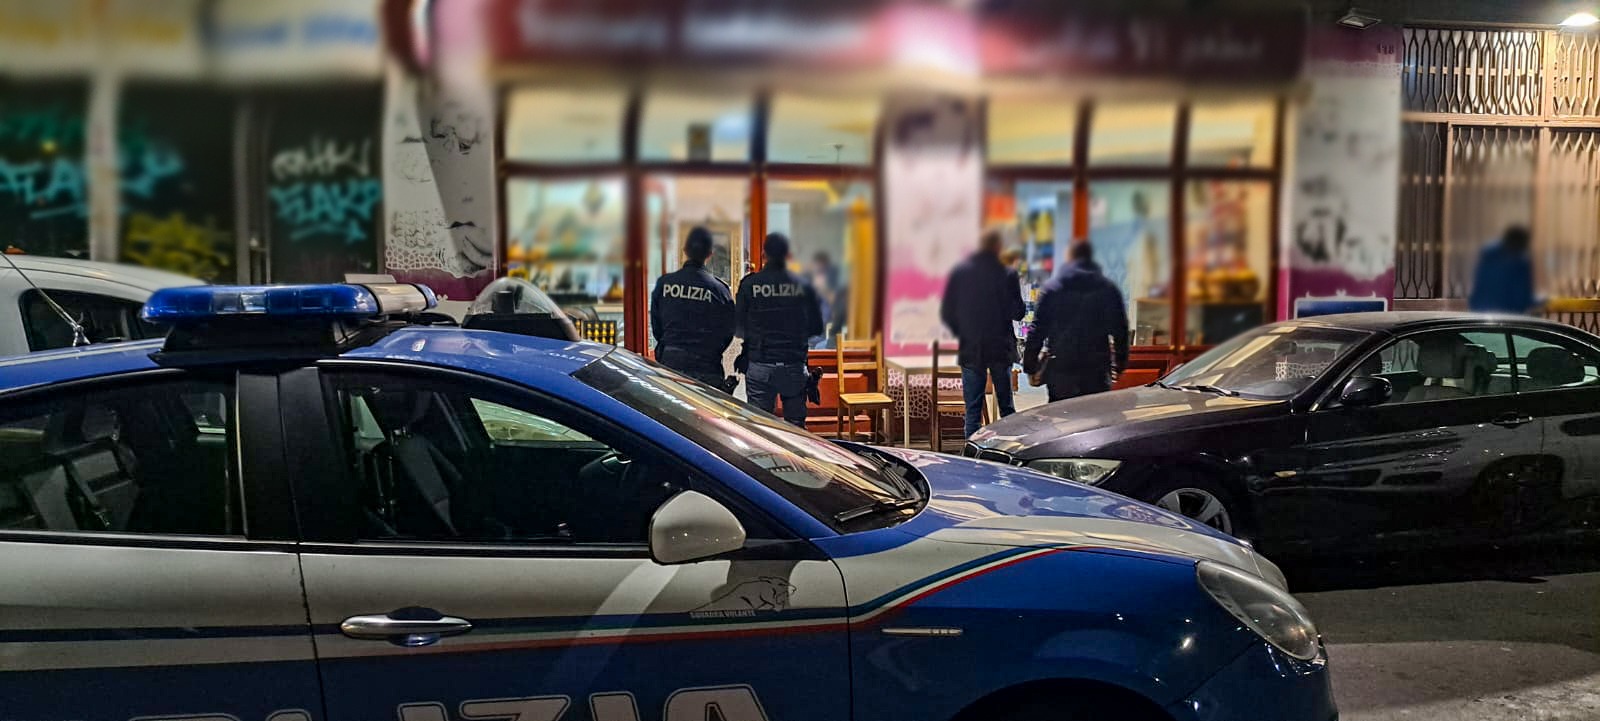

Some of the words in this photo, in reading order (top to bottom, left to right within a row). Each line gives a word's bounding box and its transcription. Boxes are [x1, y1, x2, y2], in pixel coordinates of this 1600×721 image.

[662, 283, 712, 303] POLIZIA
[752, 283, 805, 298] POLIZIA
[723, 609, 756, 617] VOLANTE
